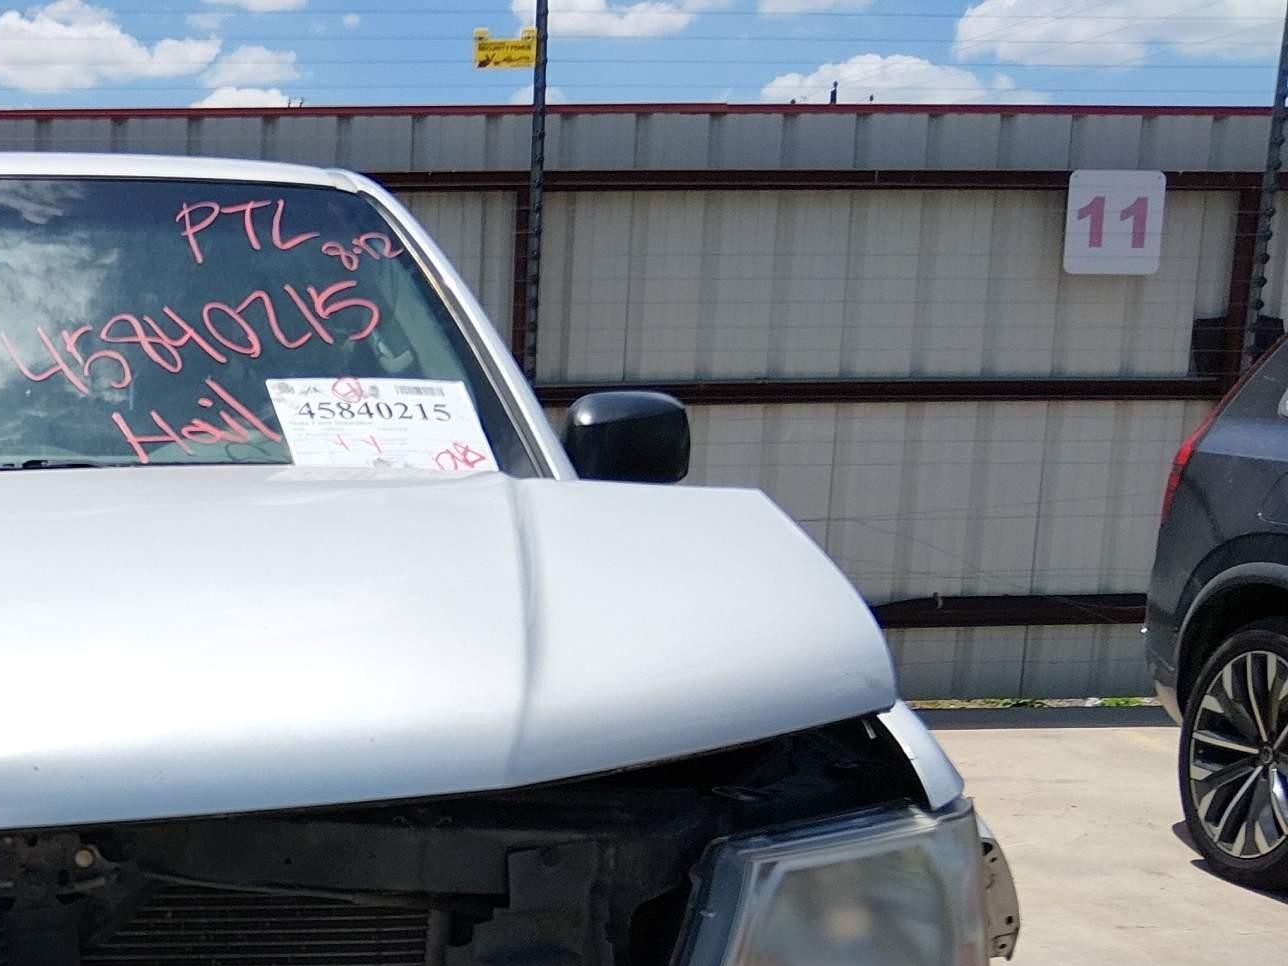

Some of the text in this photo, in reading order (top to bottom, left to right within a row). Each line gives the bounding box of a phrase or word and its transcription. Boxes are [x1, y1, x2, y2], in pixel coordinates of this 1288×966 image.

[176, 199, 320, 264] PTL
[1077, 195, 1149, 248] 11
[0, 280, 380, 395] 45840215
[112, 375, 282, 464] Hail
[298, 401, 452, 422] 45840215
